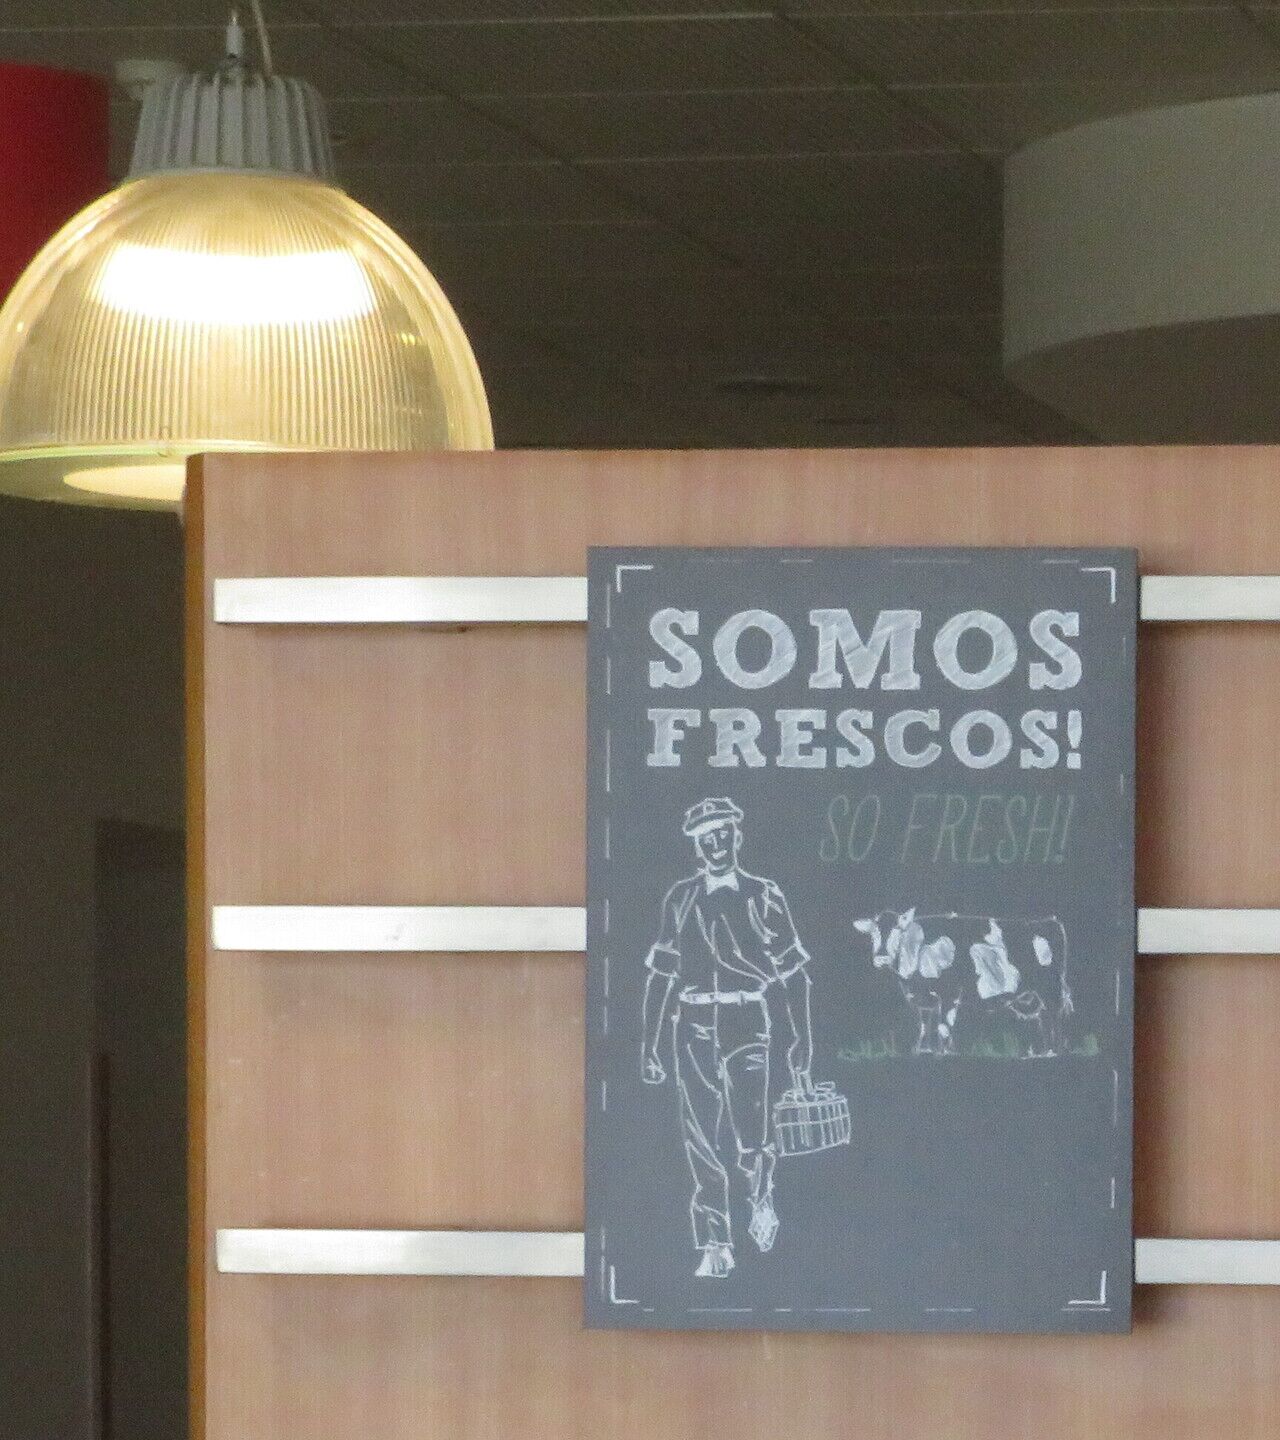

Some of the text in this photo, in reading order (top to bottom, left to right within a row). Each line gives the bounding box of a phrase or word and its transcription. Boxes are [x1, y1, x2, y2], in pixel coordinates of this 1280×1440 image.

[648, 608, 1083, 690] SOMOS
[645, 707, 1084, 770] FRESCOS!
[818, 794, 1076, 865] SO FRESH!
